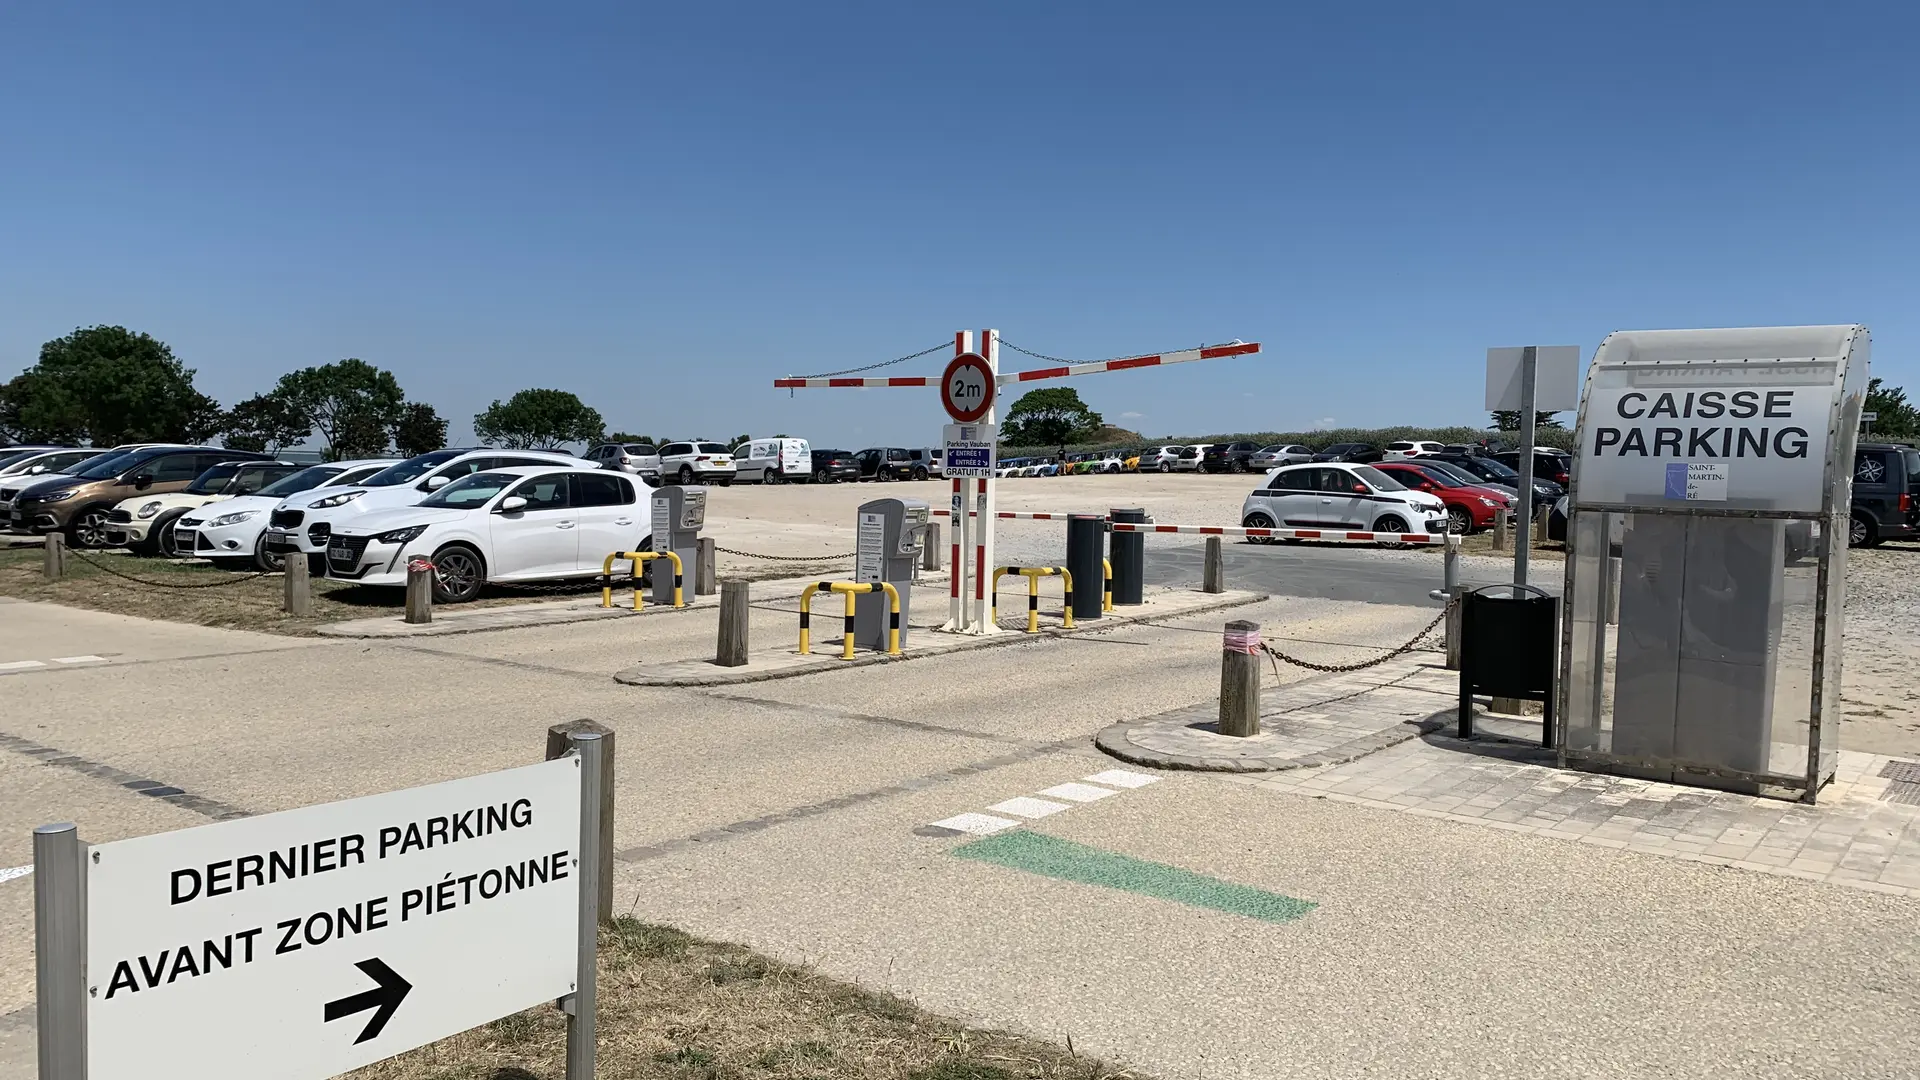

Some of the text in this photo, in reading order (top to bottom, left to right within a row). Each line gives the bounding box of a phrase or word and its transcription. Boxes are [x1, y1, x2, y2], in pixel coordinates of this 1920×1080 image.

[954, 380, 980, 397] 2m
[1617, 391, 1794, 419] CAISSE
[1594, 426, 1809, 459] PARKING
[946, 468, 991, 476] GRATUIT 1H
[955, 458, 976, 466] ENTRÉE
[1687, 491, 1698, 499] RÉ
[170, 798, 533, 905] DERNIER PARKING
[104, 850, 569, 1000] AVANT ZONE PIÉTONNE
